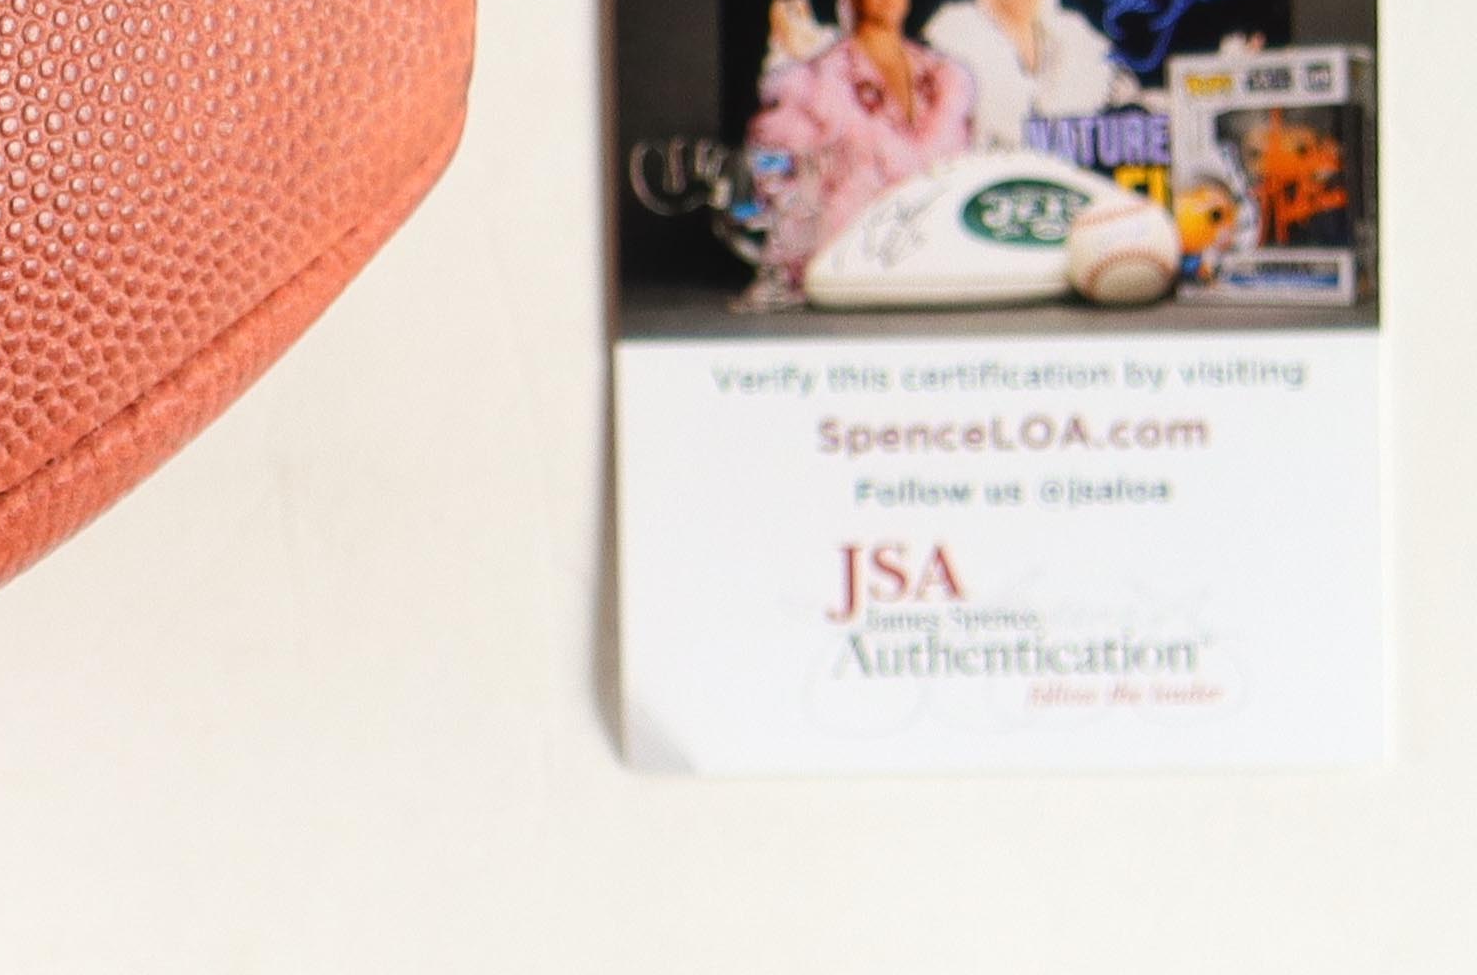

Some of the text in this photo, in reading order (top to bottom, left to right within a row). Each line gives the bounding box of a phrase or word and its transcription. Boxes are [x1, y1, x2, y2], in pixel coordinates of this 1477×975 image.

[711, 358, 1310, 395] Verify this certification by visiting
[817, 414, 1211, 459] SpenceLOA.com
[854, 479, 974, 508] Follow
[984, 481, 1023, 506] us
[824, 542, 966, 624] JSA
